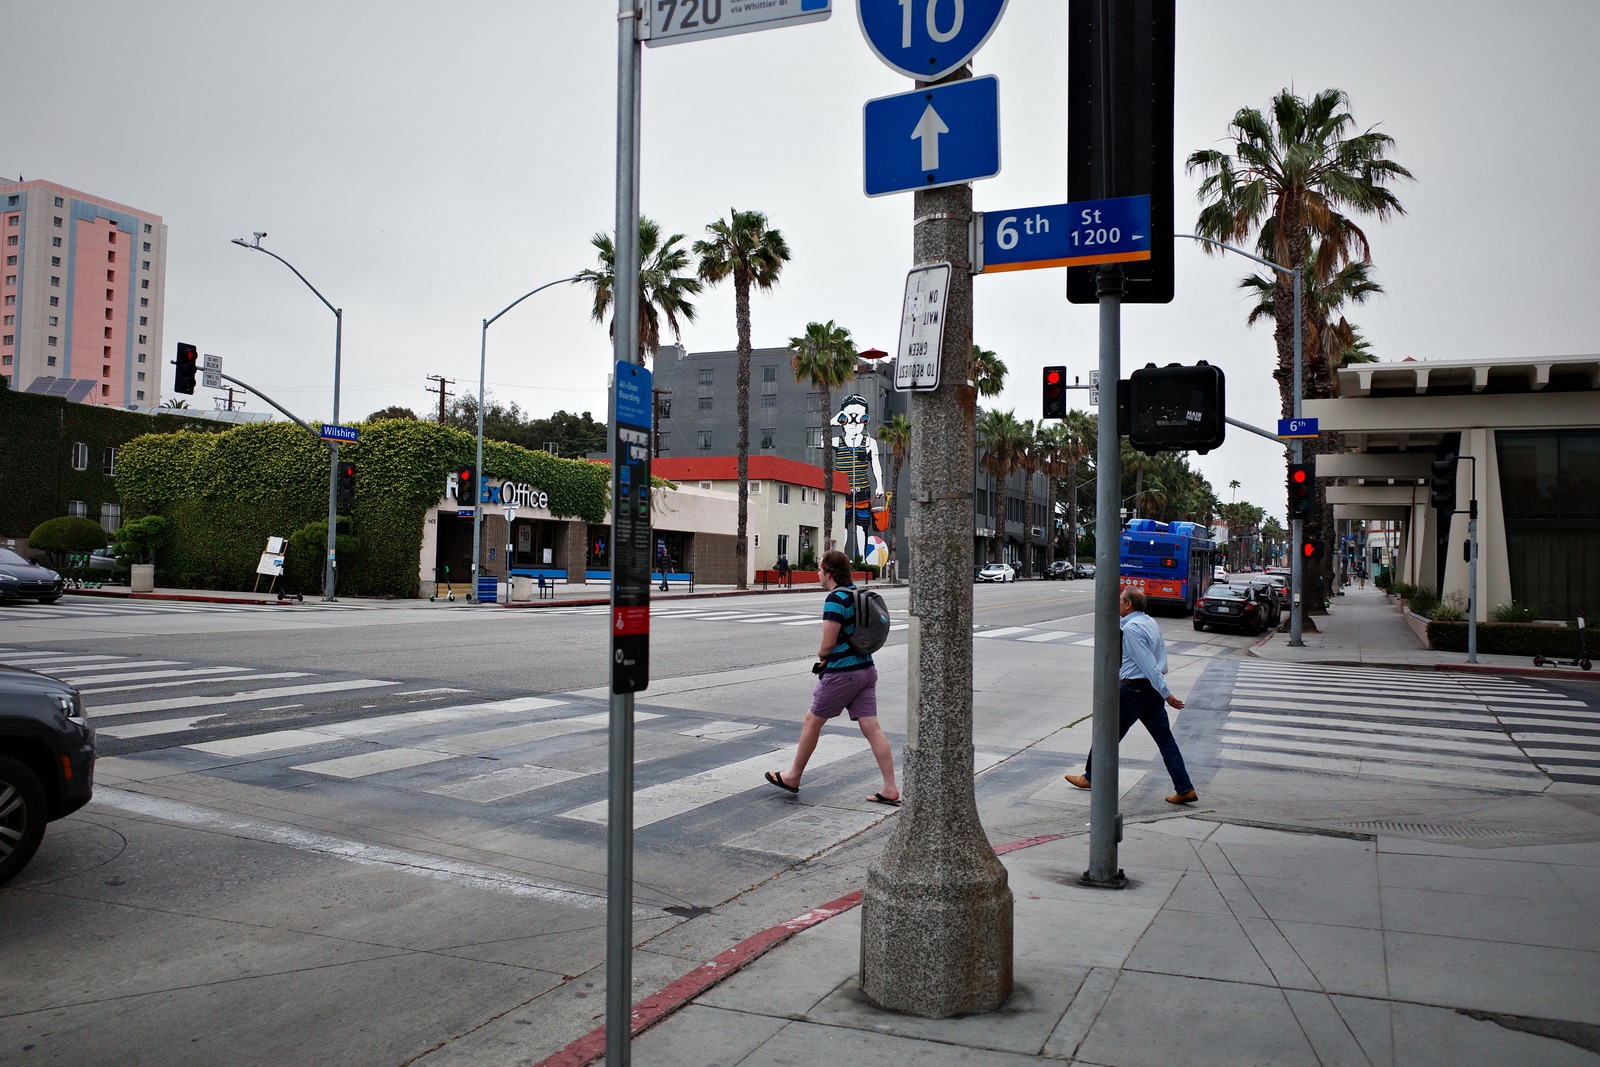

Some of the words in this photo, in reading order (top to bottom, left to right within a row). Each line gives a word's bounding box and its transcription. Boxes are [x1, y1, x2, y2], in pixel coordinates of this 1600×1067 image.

[657, 0, 722, 32] 720
[731, 6, 743, 14] via
[744, 1, 777, 12] Whittier
[897, 0, 964, 48] 10
[1081, 208, 1102, 225] St
[996, 214, 1050, 250] 6th
[1071, 227, 1121, 247] 1200
[928, 290, 939, 304] ON
[923, 311, 939, 326] WAIT
[324, 426, 355, 438] Wilshire
[1290, 420, 1306, 432] 6th
[503, 481, 549, 509] Office
